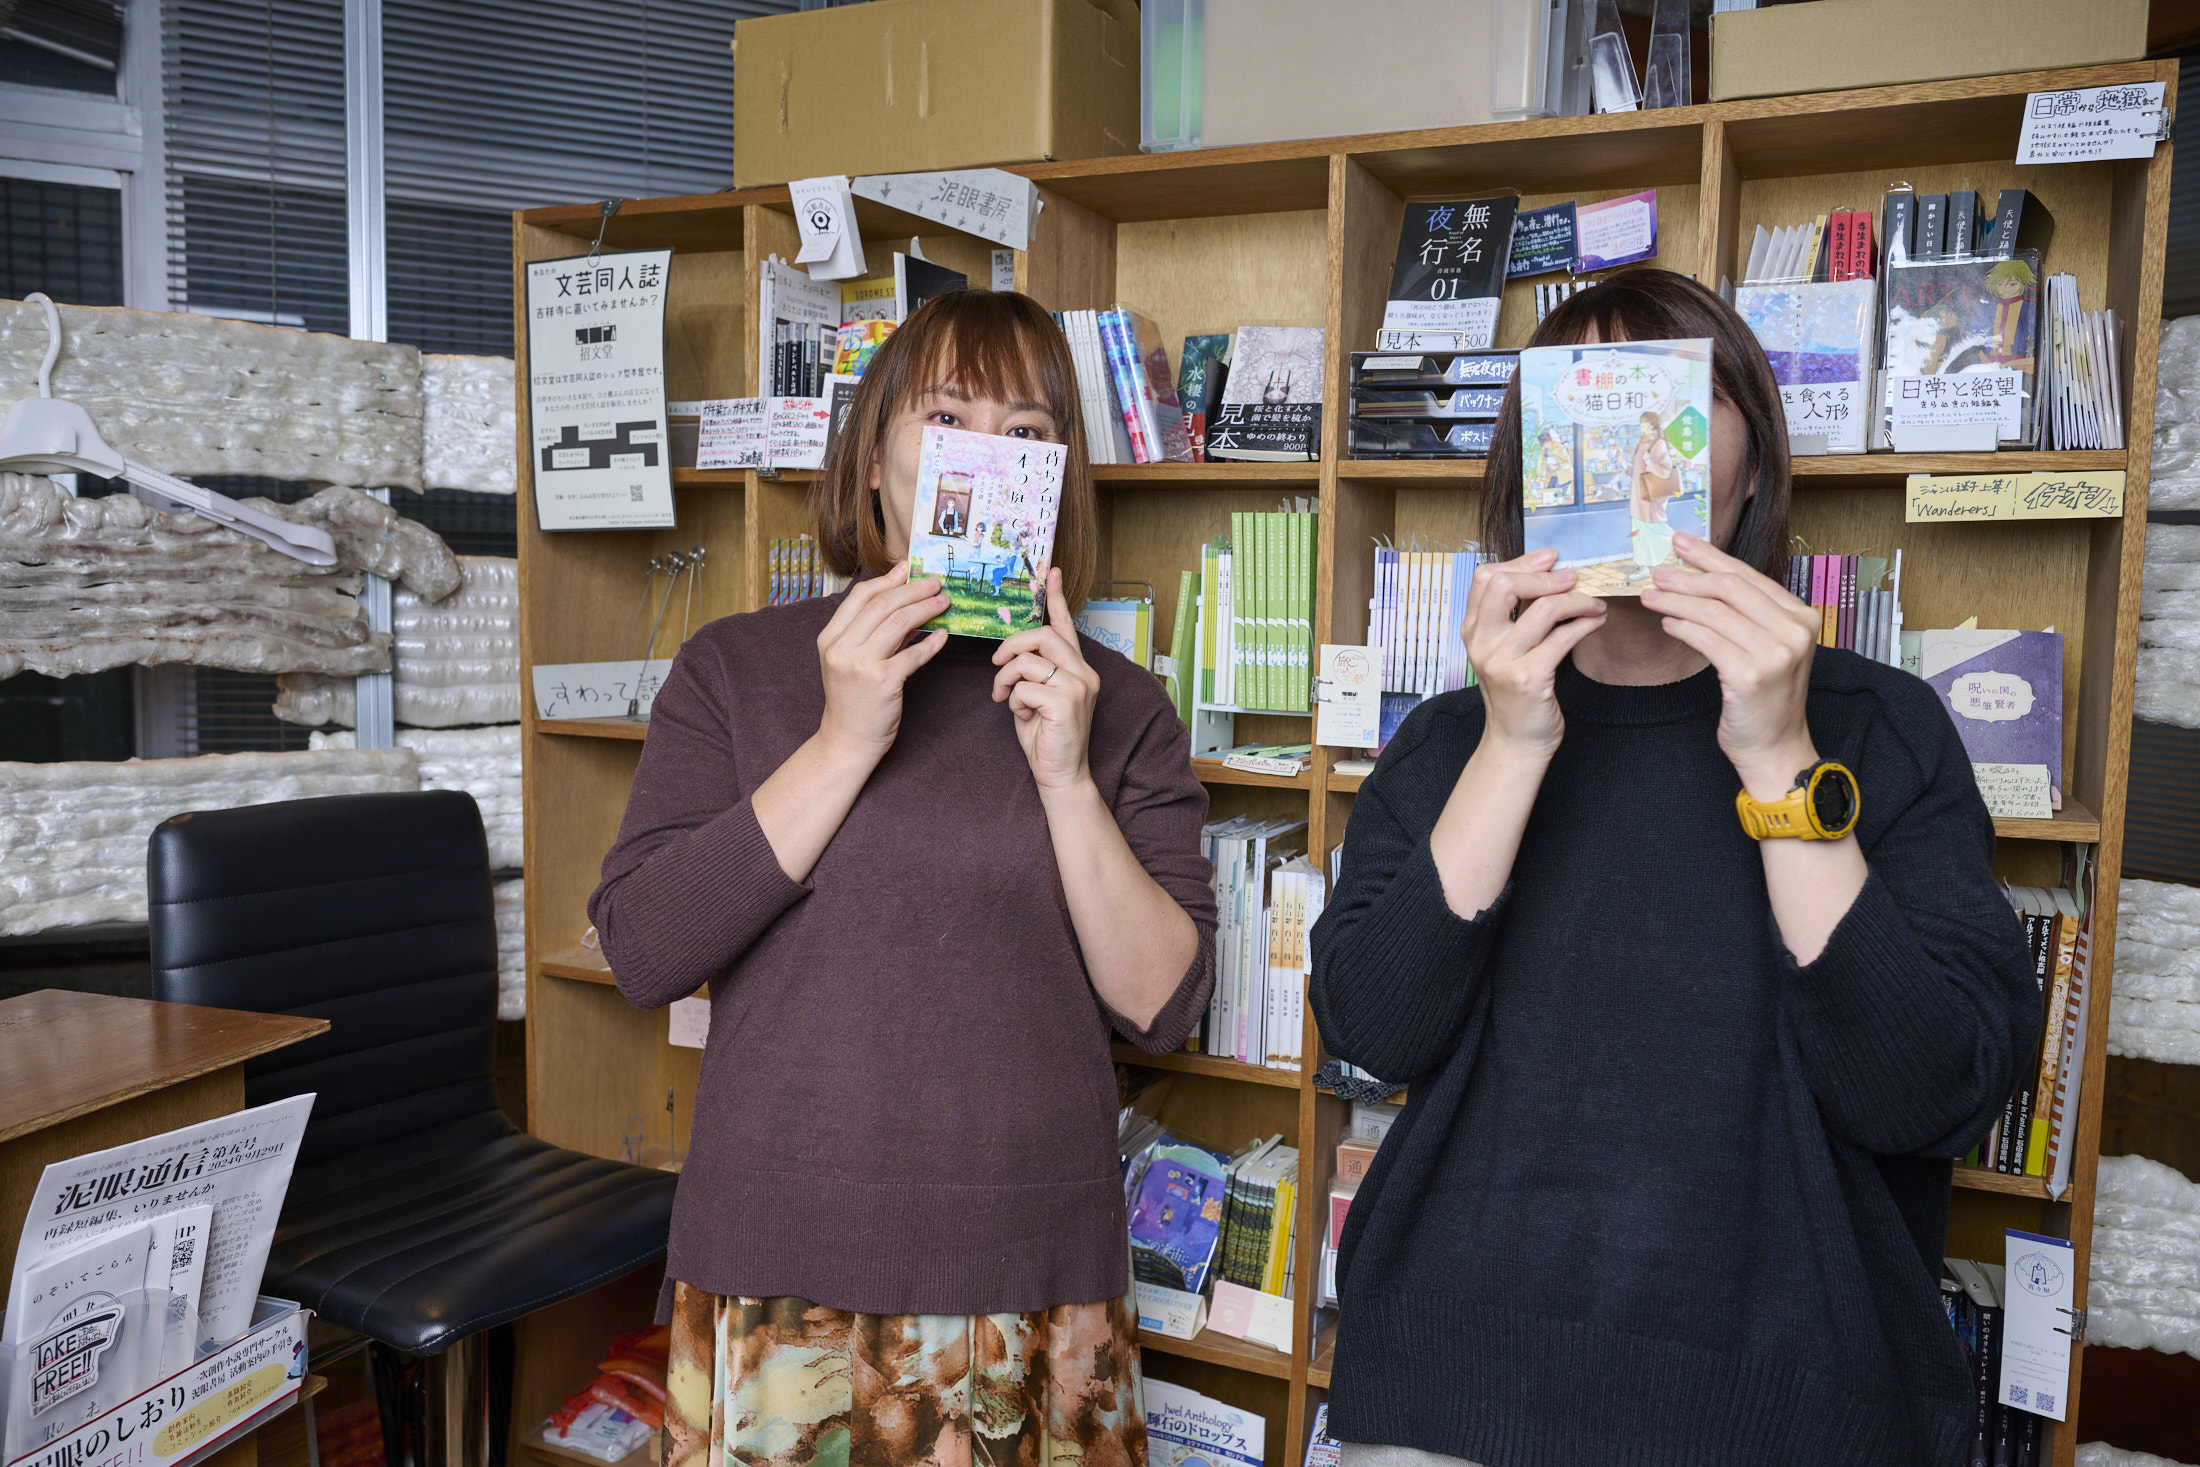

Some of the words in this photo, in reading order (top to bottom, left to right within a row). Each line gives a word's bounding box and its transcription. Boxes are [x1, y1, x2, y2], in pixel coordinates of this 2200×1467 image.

[2031, 87, 2160, 119] 日常から地獄まで
[930, 177, 1014, 222] 泥眼書房
[1420, 205, 1456, 266] 夜行
[1456, 204, 1491, 264] 無名
[1925, 203, 1937, 255] 輝かしい日々
[533, 268, 556, 276] あなたの
[555, 263, 661, 298] 文芸同人誌
[1430, 277, 1459, 300] 01
[536, 294, 658, 319] 吉祥寺に置いてみませんか？
[579, 343, 613, 361] 招文堂
[1386, 332, 1421, 350] 見本
[534, 367, 662, 386] 招文堂は文芸同人誌のシェア型本屋です。
[1185, 366, 1203, 411] 水棲の
[1574, 363, 1660, 391] 書棚の本と
[1902, 377, 2016, 399] 日常と絶望
[1253, 404, 1313, 413] 桜と化す人々
[1459, 396, 1504, 409] バックナン
[1584, 391, 1644, 412] 猫日和
[1803, 403, 1850, 420] 人形
[1207, 404, 1245, 450] 見本
[1246, 433, 1306, 442] ゆめの終わり
[1461, 431, 1497, 443] ポスト
[1031, 450, 1060, 559] 待ち合わせは
[1968, 682, 2017, 697] 呪いの国の
[1969, 697, 2016, 711] 悪筆賢者
[207, 1142, 285, 1173] 2024年9月29日
[1347, 1160, 1363, 1175] 通
[54, 1147, 210, 1216] 泥眼通信
[212, 1137, 258, 1160] 第五号
[134, 1183, 216, 1212] いりませんか
[175, 1225, 196, 1240] HP
[32, 1349, 93, 1403] FREE!!
[191, 1371, 227, 1401] 泥眼書房
[1146, 1411, 1248, 1451] 輝石のドロップス
[1162, 1403, 1185, 1417] Jwel
[1185, 1410, 1234, 1433] Anthology
